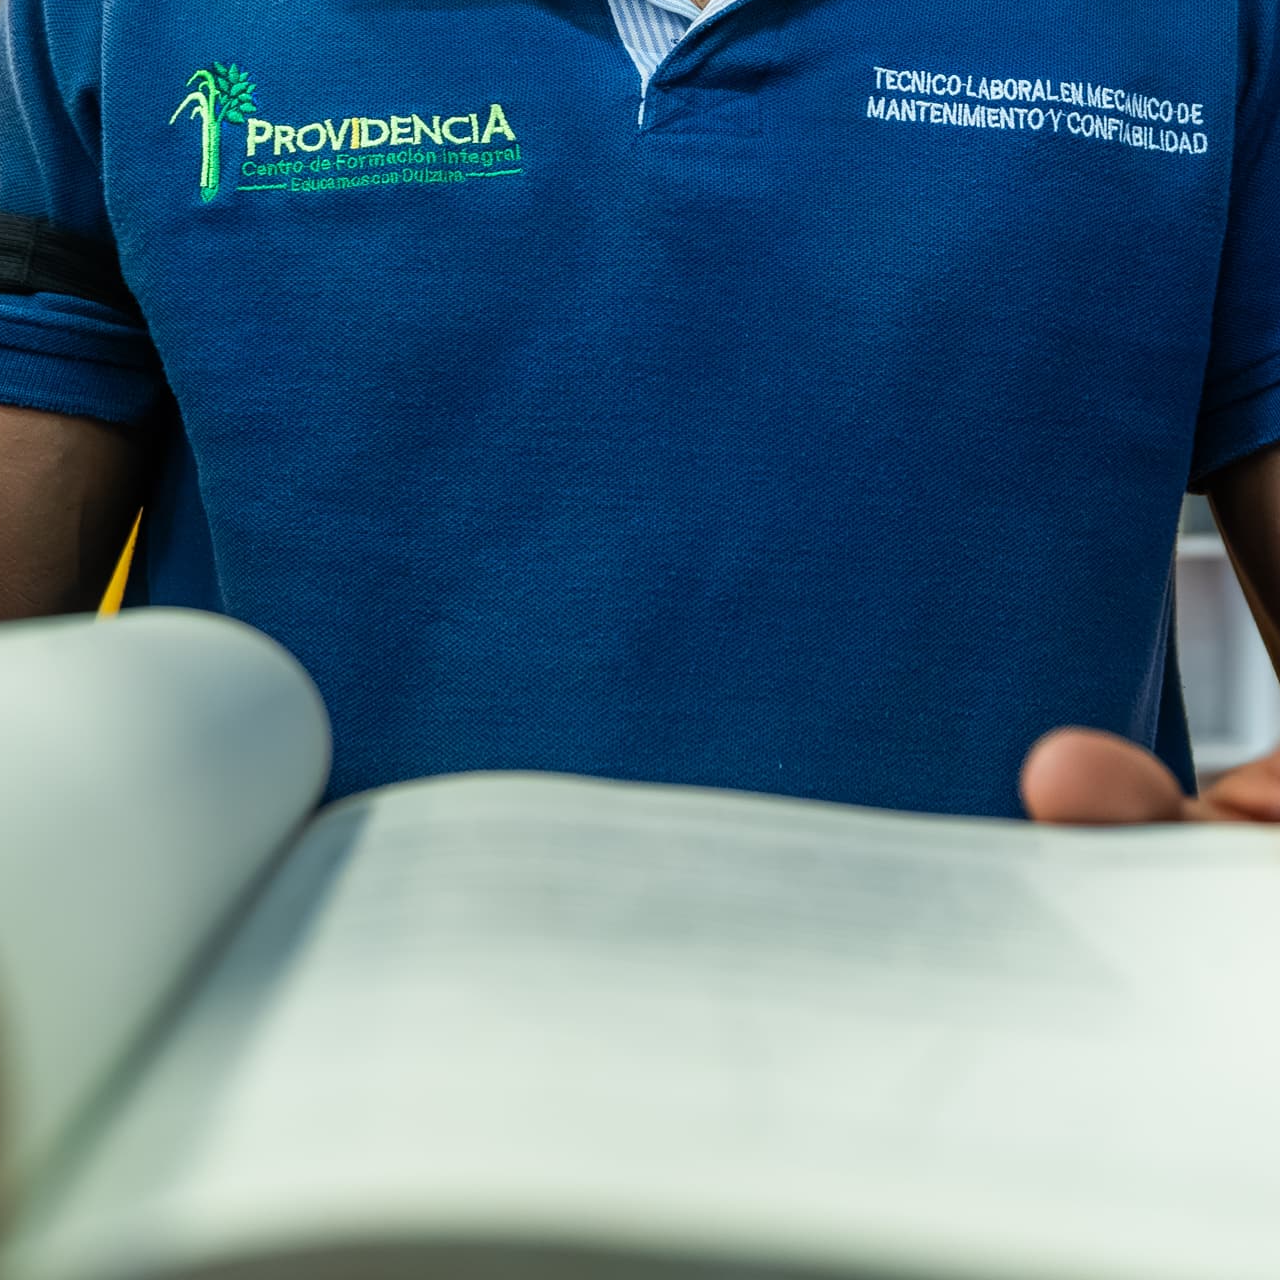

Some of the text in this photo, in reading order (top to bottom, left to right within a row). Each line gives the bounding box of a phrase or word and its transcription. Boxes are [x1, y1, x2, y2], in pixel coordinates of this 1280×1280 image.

[873, 66, 1204, 126] TECNICO LABORAL EN MECANICO DE
[246, 103, 517, 157] PROVIDENCIA
[866, 95, 1208, 154] MANTENIMIENTO Y CONFIABILIDAD
[241, 159, 304, 177] Centro
[309, 155, 332, 172] de
[290, 174, 370, 193] Educamos
[371, 171, 399, 185] con
